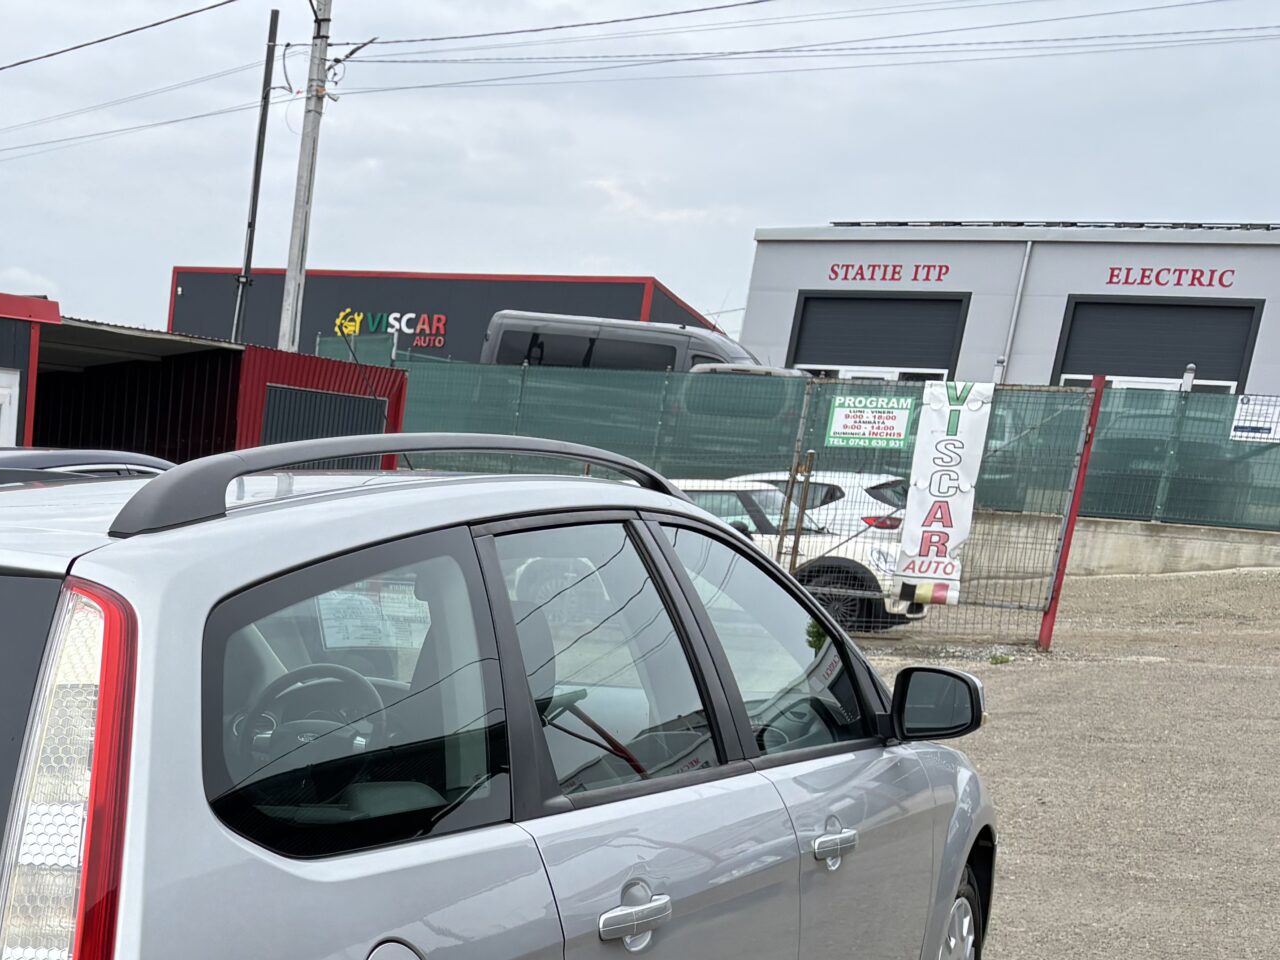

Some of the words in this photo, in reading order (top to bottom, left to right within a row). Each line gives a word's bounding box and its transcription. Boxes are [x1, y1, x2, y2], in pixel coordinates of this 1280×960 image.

[828, 263, 903, 281] STATIE
[911, 264, 950, 282] ITP
[1105, 266, 1236, 288] ELECTRIC
[366, 312, 447, 335] VISCAR
[413, 336, 445, 348] AUTO
[835, 396, 912, 409] PROGRAM
[848, 438, 869, 447] 0743
[871, 439, 887, 447] 639
[889, 439, 904, 448] 931
[902, 559, 956, 577] AUTO
